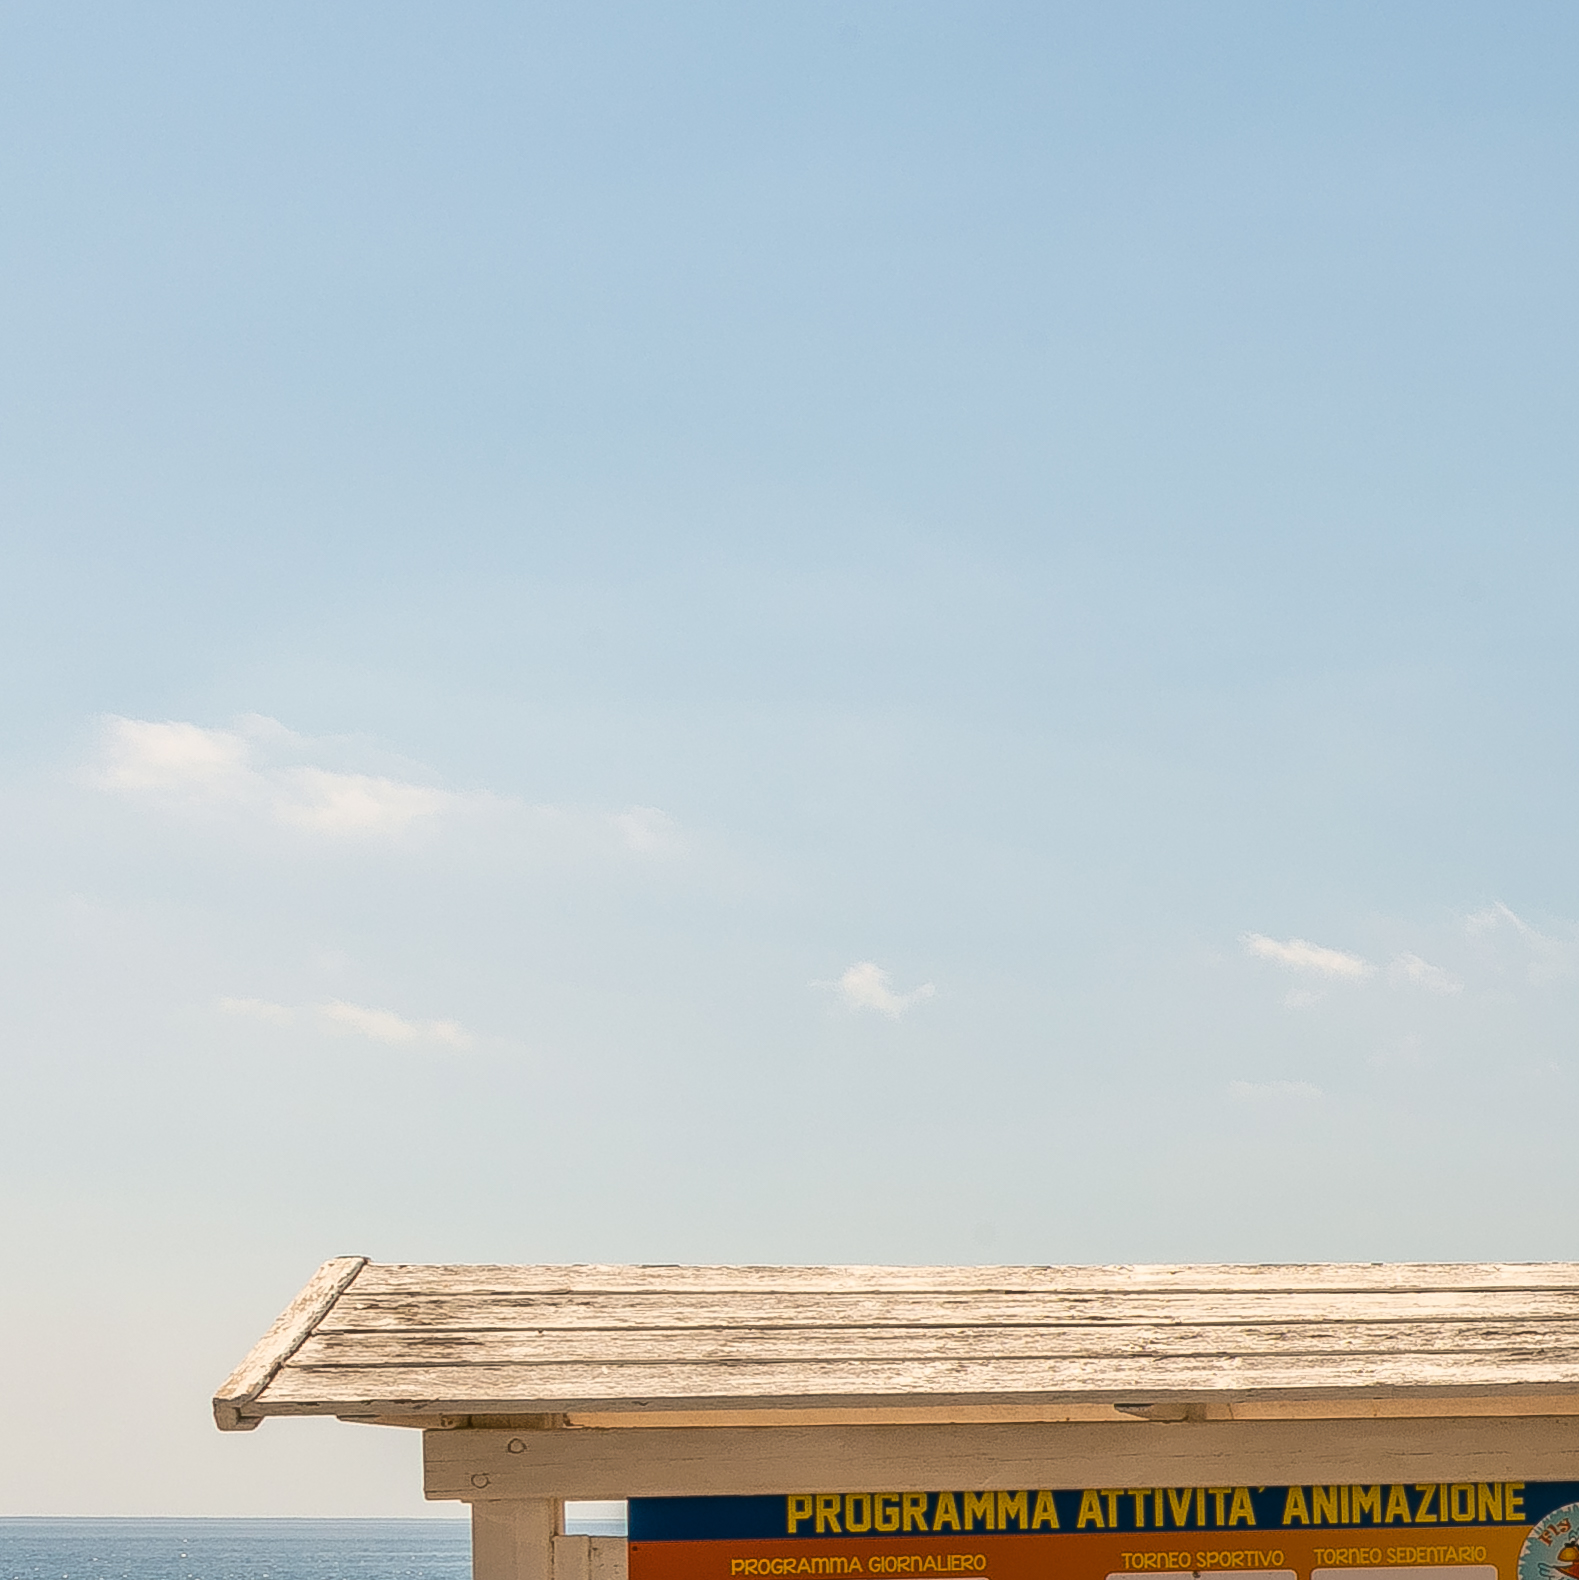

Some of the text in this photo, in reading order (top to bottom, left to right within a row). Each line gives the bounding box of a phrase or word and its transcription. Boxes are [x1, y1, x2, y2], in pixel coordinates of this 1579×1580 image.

[787, 1489, 1060, 1533] PROGRAMMA
[1283, 1482, 1526, 1525] ANIMAZIONE
[1538, 1517, 1572, 1547] Fly
[731, 1554, 987, 1576] PROGRAMMA GIORNALIERO
[1121, 1550, 1285, 1569] TORNEO SPORTIVO
[1314, 1546, 1487, 1565] TORNEO SEDENTARIO
